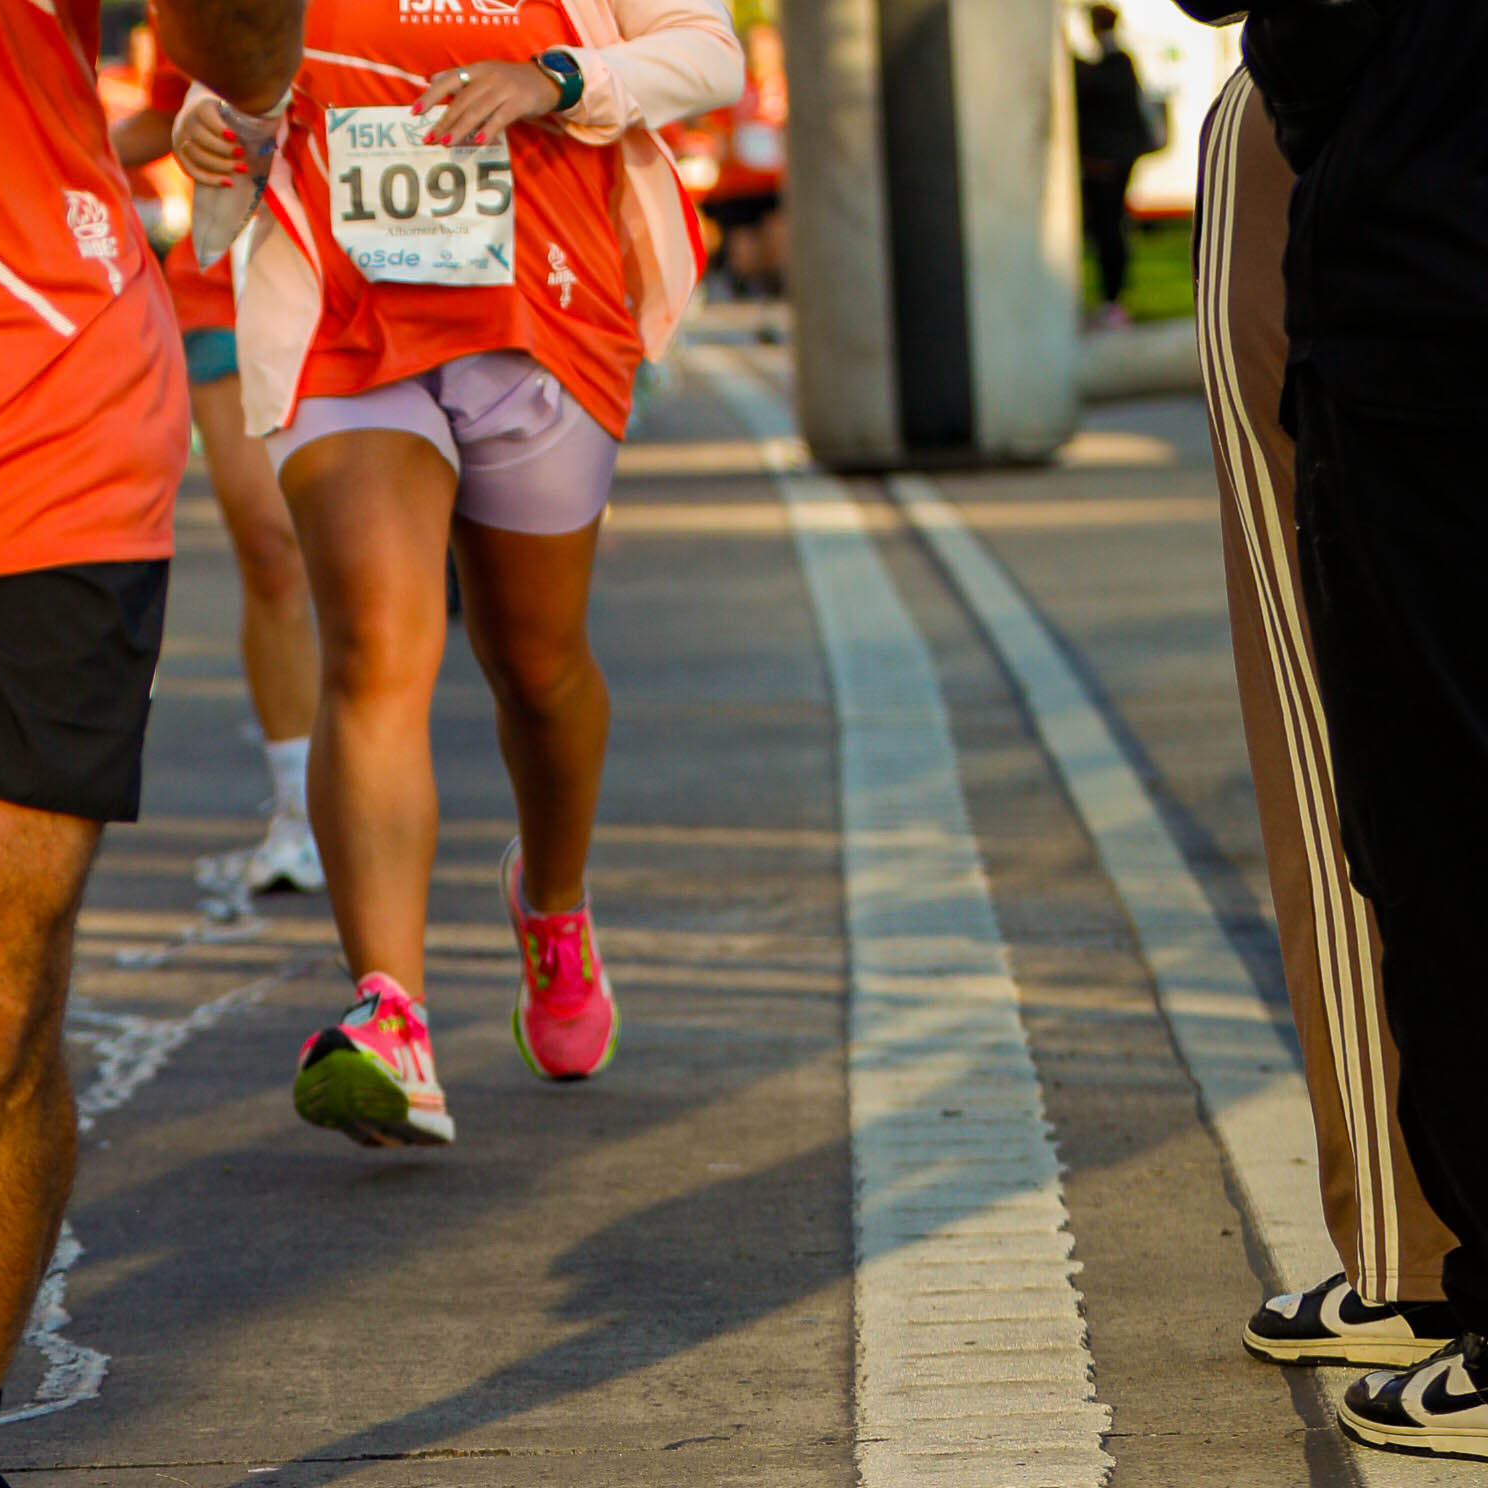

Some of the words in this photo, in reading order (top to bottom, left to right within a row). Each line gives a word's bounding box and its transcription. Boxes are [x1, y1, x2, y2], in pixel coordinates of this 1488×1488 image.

[347, 121, 396, 148] 15K
[339, 160, 512, 221] 1095
[358, 248, 420, 268] osde
